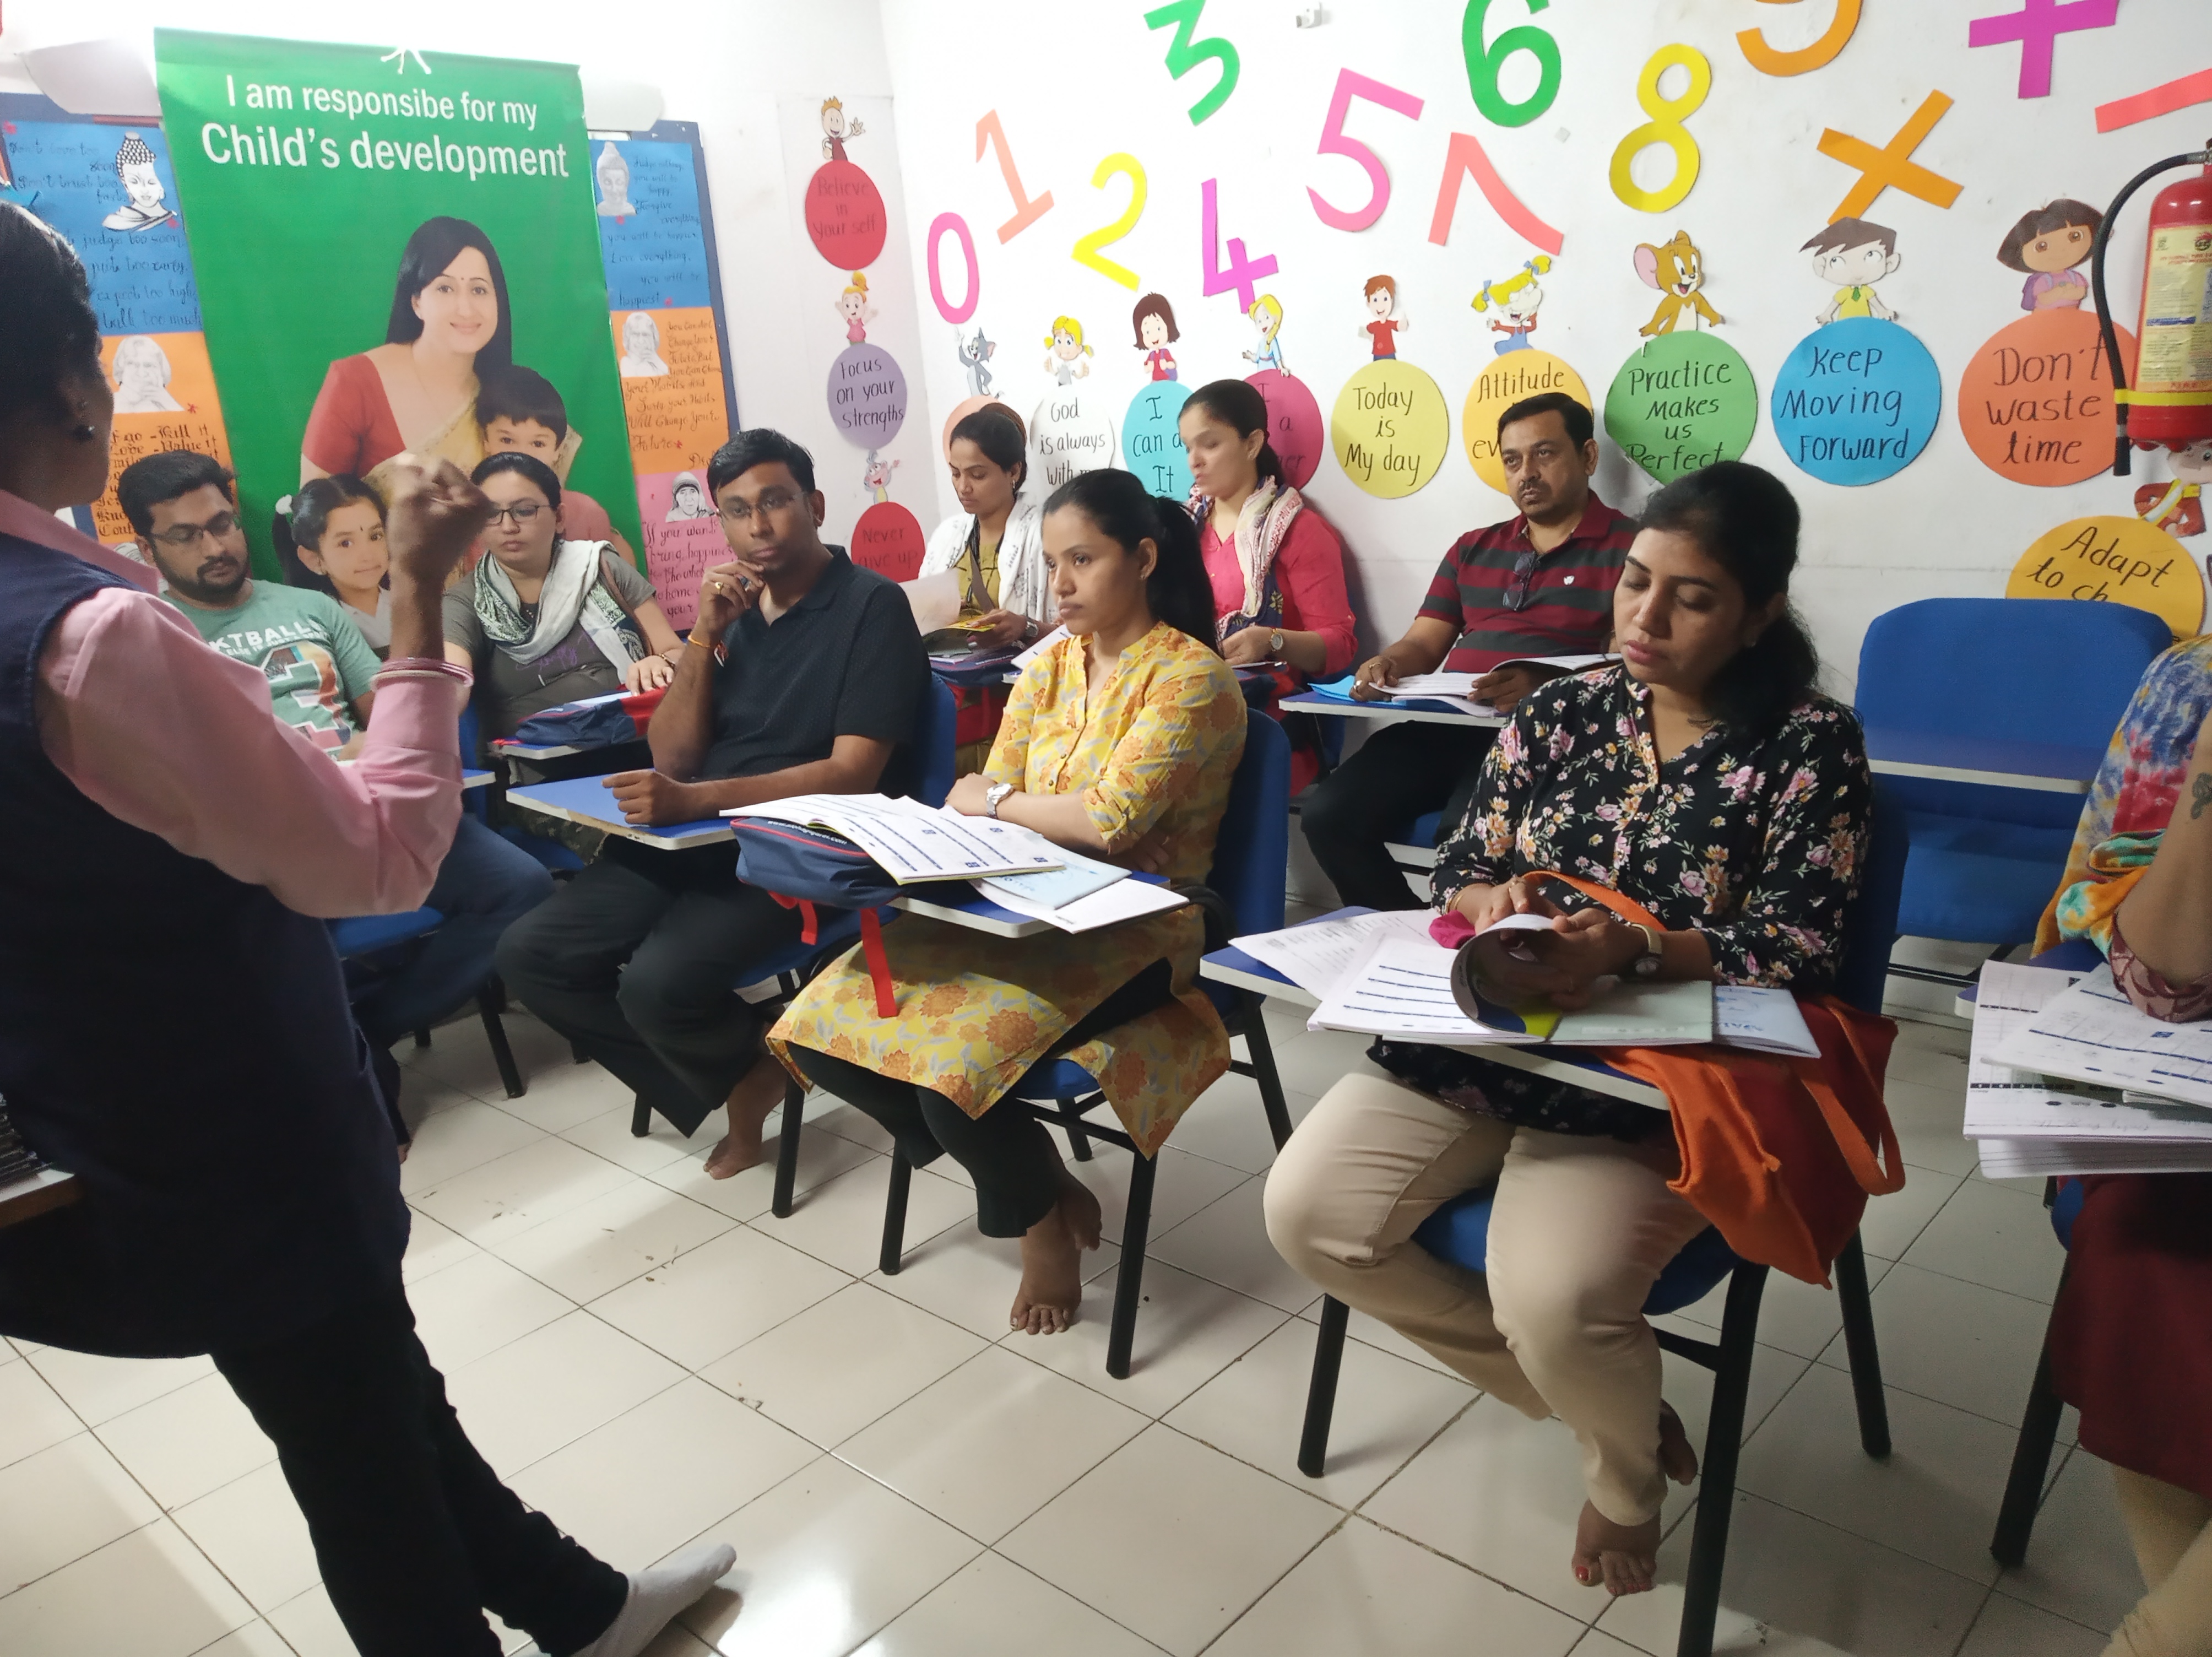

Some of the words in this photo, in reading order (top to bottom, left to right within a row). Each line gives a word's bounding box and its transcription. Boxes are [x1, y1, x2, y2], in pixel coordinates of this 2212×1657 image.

[1143, 0, 1240, 127] 3
[1462, 0, 1562, 128] 6
[226, 75, 236, 106] I
[246, 84, 293, 110] am
[302, 87, 454, 121] responsibe
[460, 91, 496, 122] for
[502, 101, 538, 131] my
[1608, 43, 1712, 213] 8
[202, 122, 341, 169] Child's
[350, 131, 570, 181] development
[1305, 67, 1425, 232] 5
[818, 176, 870, 196] Believe
[975, 109, 1055, 245] 1
[1428, 132, 1564, 256] 7
[836, 204, 848, 216] in
[1071, 152, 1147, 292] 2
[1201, 178, 1279, 314] 4
[841, 359, 882, 380] Focus
[1993, 329, 2107, 386] Don't
[837, 387, 854, 405] on
[863, 381, 895, 402] your
[1258, 383, 1270, 403] I
[1477, 362, 1564, 403] Attitude
[1629, 361, 1732, 396] Practice
[1050, 397, 1080, 423] God
[1146, 396, 1163, 421] I
[1352, 382, 1413, 416] Today
[1780, 386, 1902, 426] Moving
[1986, 389, 2101, 426] waste
[1280, 416, 1292, 431] a
[1375, 415, 1395, 438] is
[1665, 424, 1692, 440] us
[1040, 434, 1054, 455] is
[1056, 432, 1105, 453] always
[1626, 442, 1724, 471] Perfect
[1801, 428, 1910, 463] Forward
[2002, 430, 2083, 464] time
[1152, 465, 1174, 492] It
[1344, 443, 1373, 481] My
[1383, 445, 1421, 486] day
[863, 527, 905, 544] Never
[898, 551, 918, 569] up
[2026, 556, 2064, 588] to
[2061, 526, 2174, 587] Adapt
